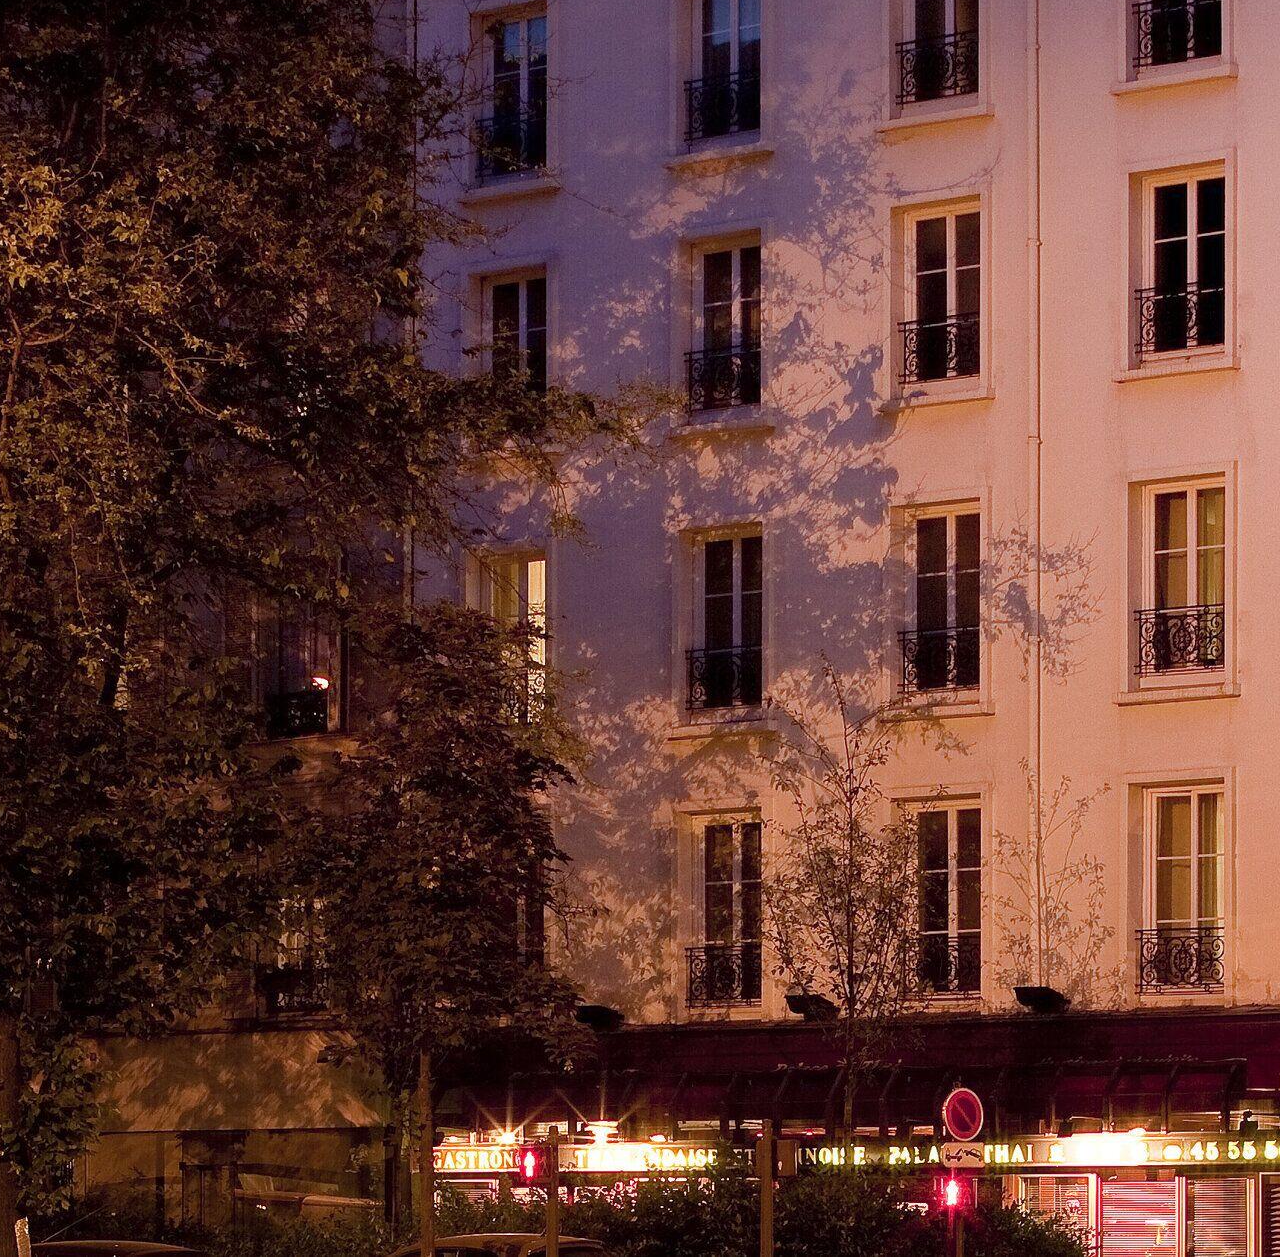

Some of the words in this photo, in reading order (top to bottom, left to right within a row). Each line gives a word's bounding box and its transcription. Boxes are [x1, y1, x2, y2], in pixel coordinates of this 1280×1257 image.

[983, 1144, 1034, 1163] THAI
[1190, 1141, 1219, 1160] 45
[1228, 1140, 1257, 1160] 55
